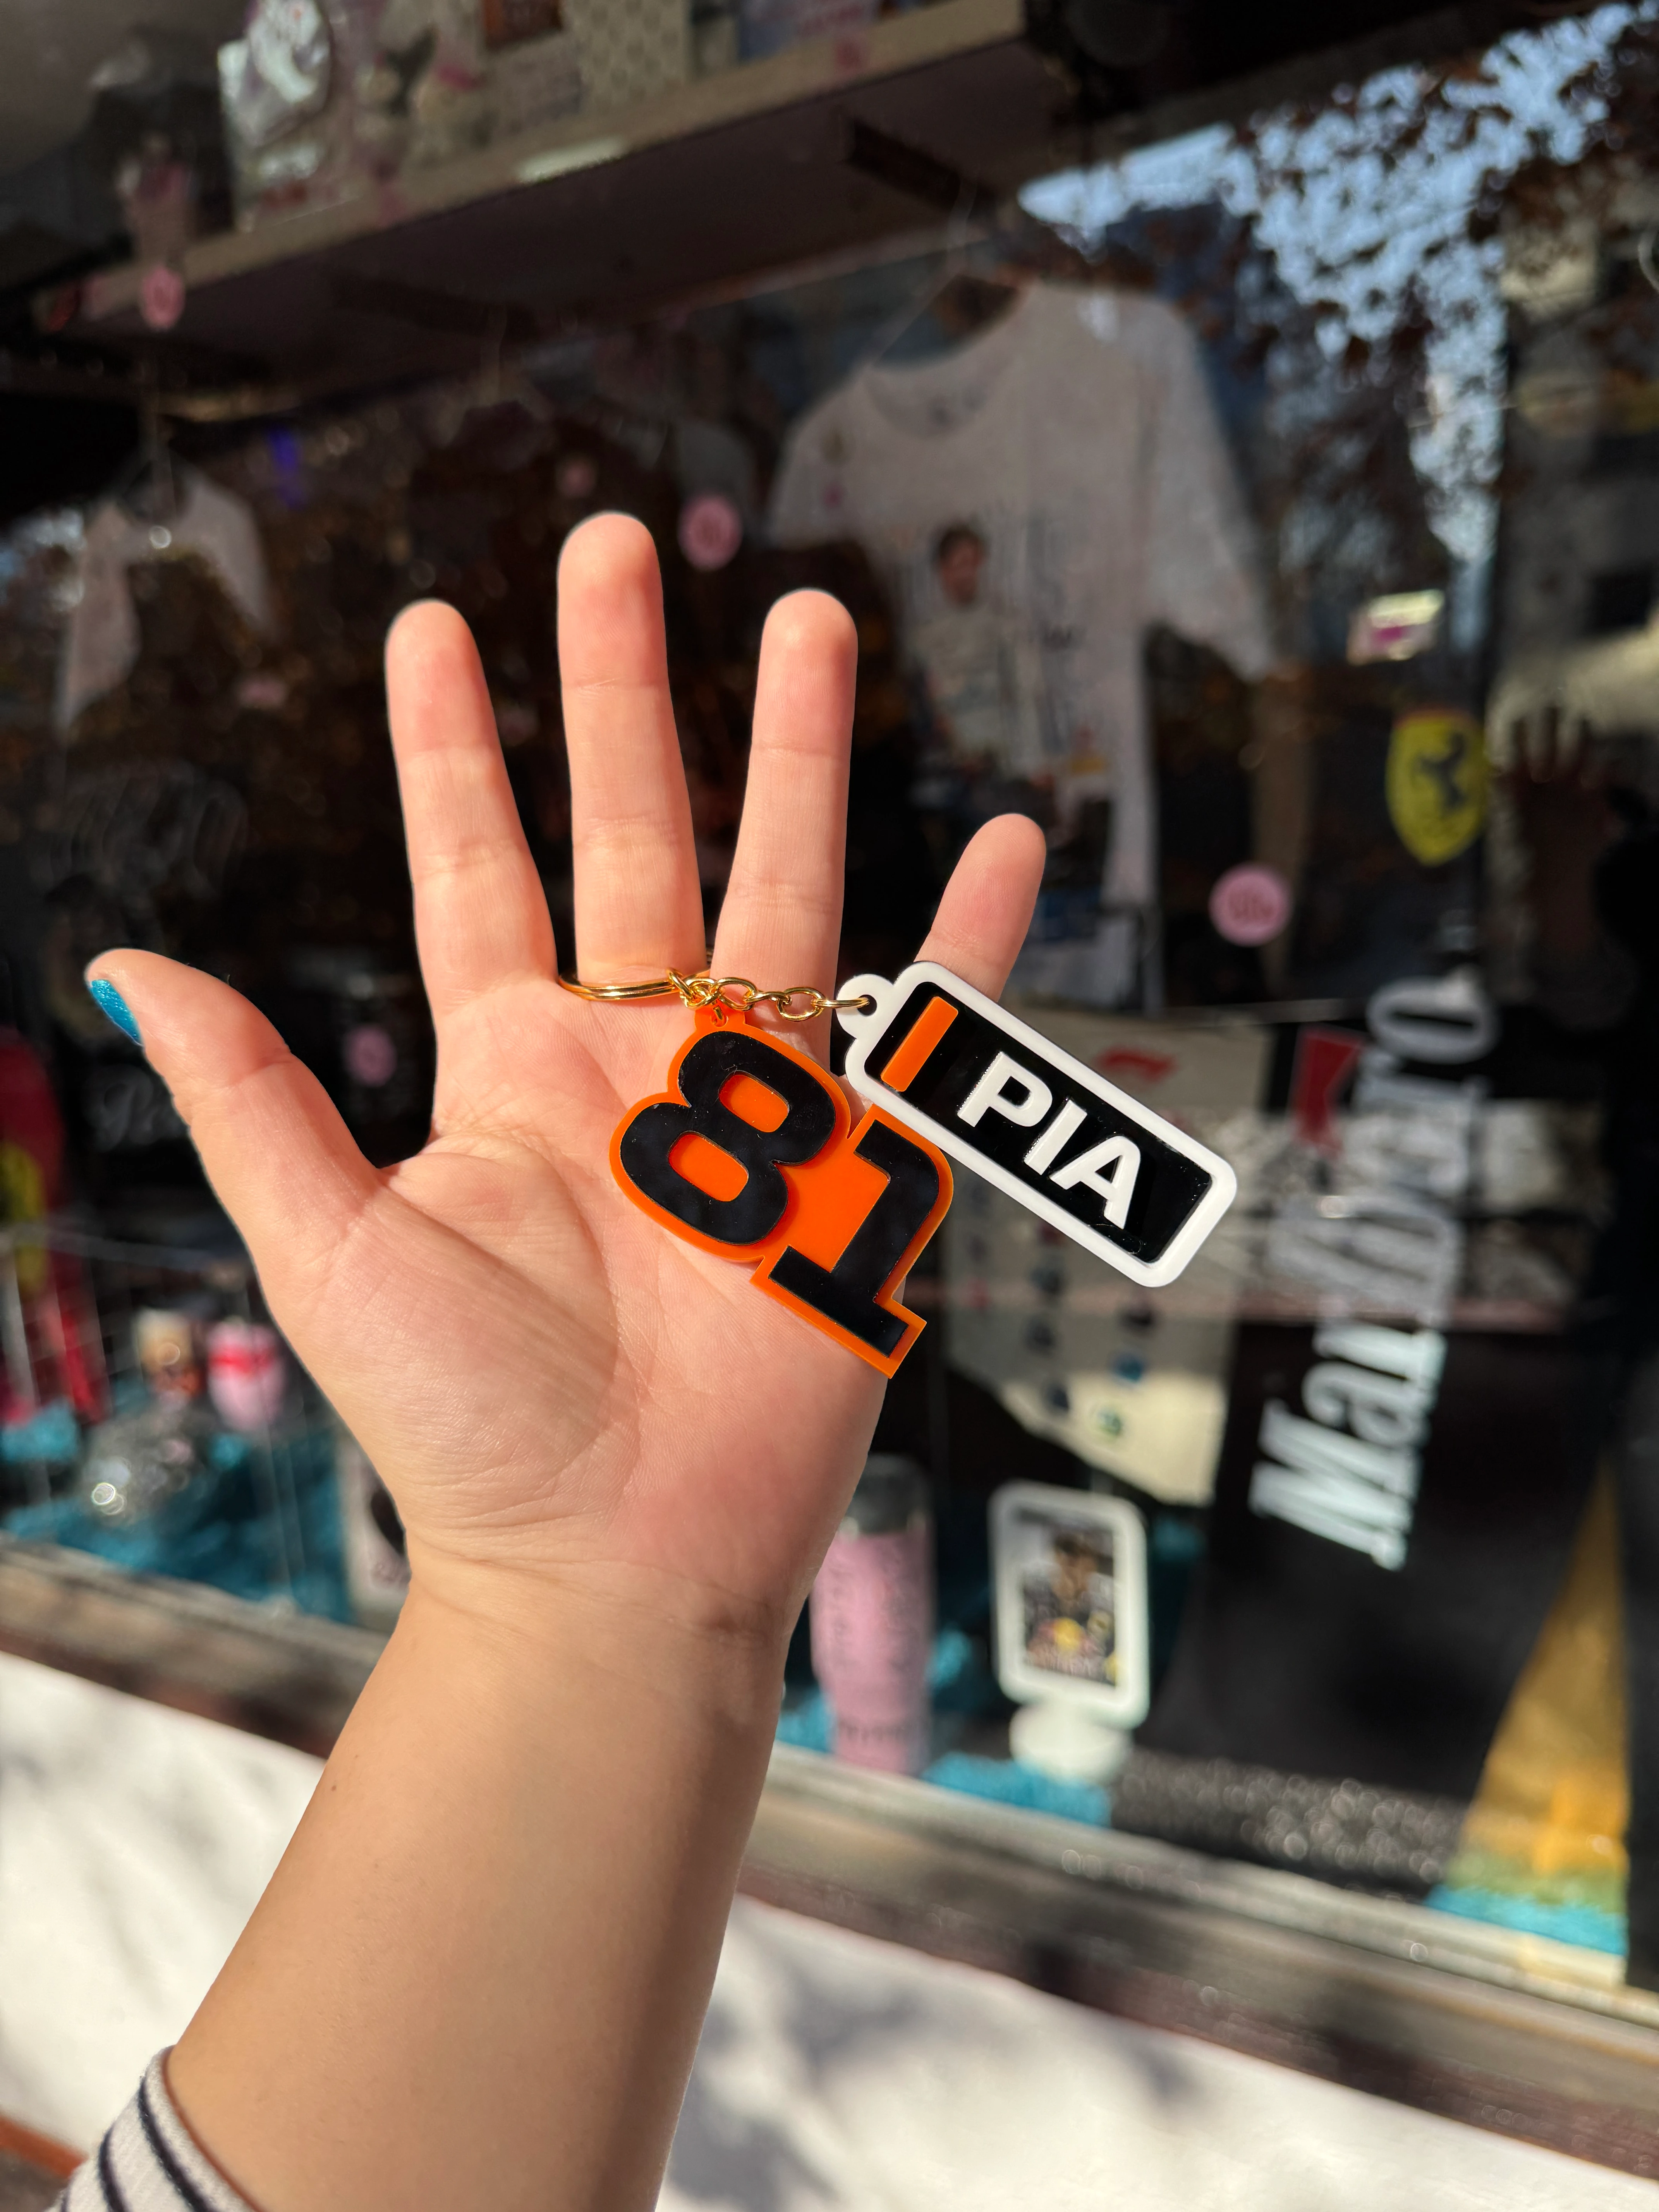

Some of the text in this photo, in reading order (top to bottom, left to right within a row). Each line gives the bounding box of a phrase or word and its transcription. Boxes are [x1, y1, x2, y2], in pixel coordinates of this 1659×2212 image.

[620, 1030, 939, 1357] 81
[957, 1051, 1141, 1229] PIA
[1248, 974, 1499, 1570] Marlboro
